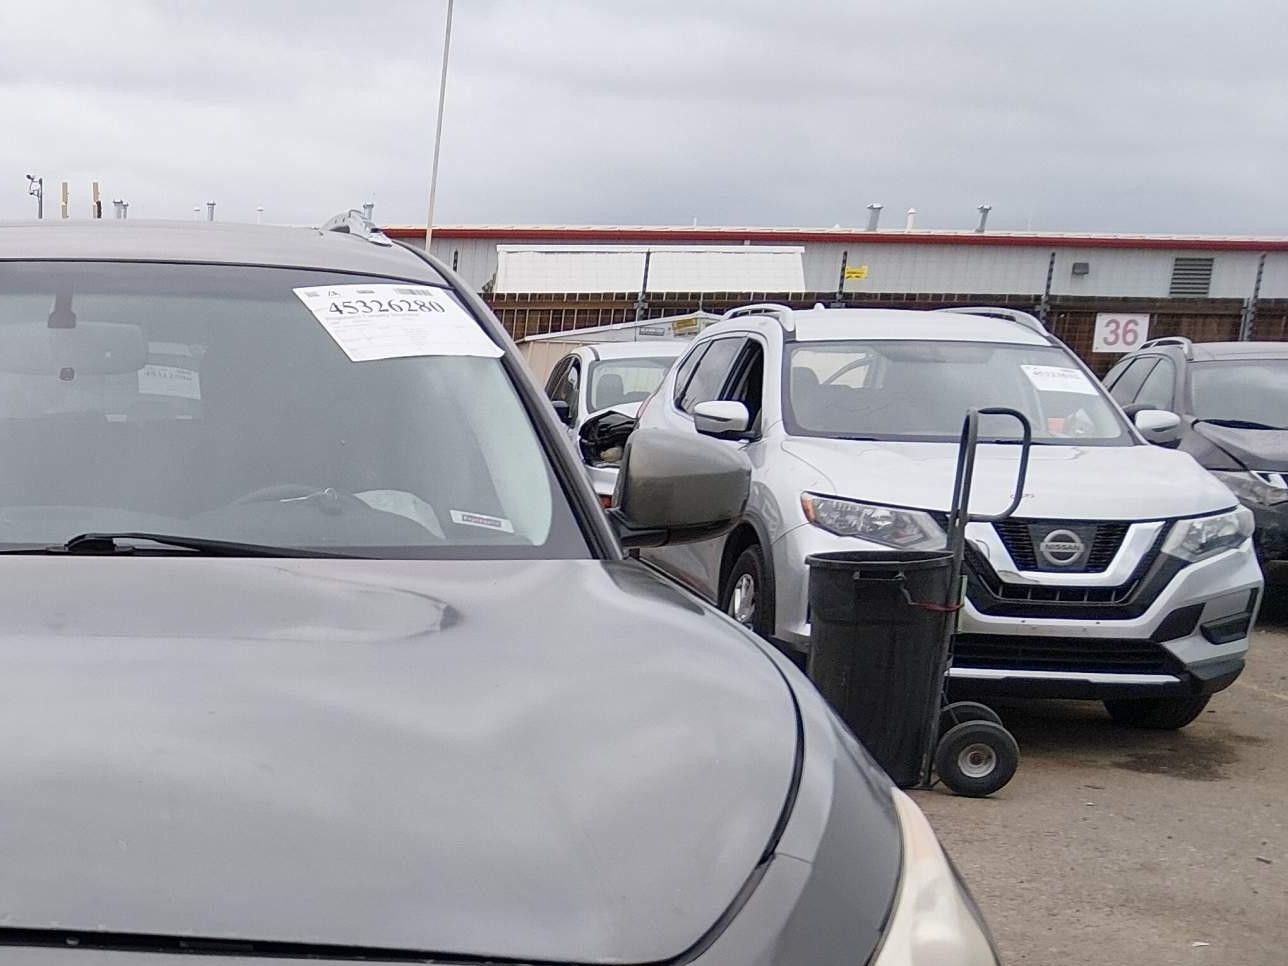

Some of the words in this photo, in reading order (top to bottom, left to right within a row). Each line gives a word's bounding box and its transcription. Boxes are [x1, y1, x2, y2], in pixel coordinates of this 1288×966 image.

[328, 298, 446, 315] 45326280
[1102, 318, 1140, 347] 36
[1045, 543, 1081, 552] NISSAN
